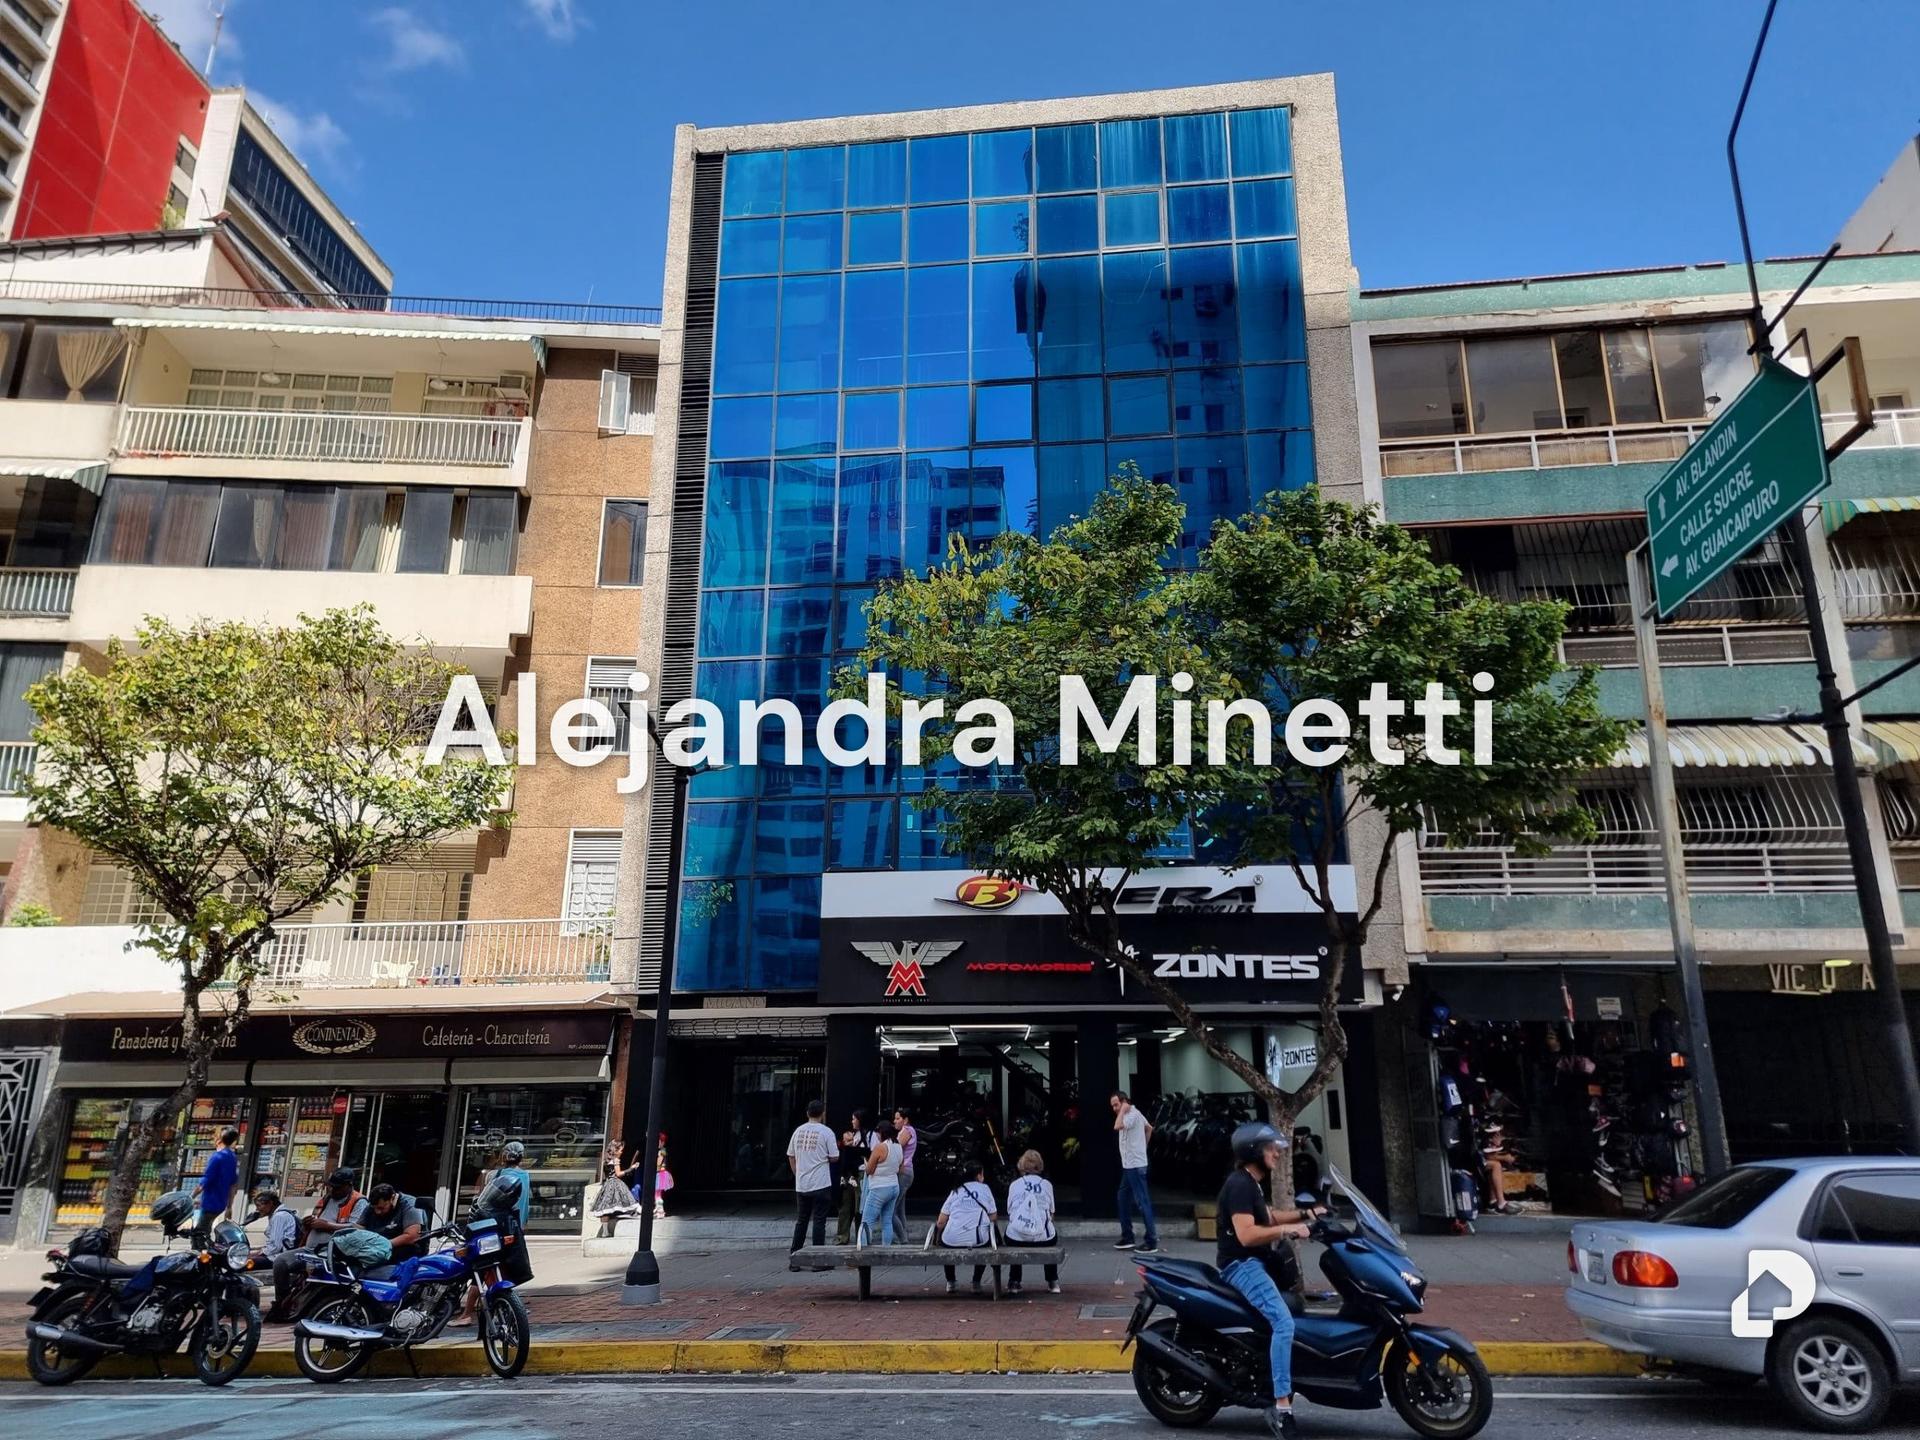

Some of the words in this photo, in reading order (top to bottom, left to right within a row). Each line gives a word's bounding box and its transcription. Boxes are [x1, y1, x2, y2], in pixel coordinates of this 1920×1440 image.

[1675, 471, 1690, 501] AV.
[1690, 421, 1738, 486] BLANDIN
[1680, 500, 1713, 546] CALLE
[1713, 463, 1754, 516] SUCRE
[1685, 550, 1700, 579] AV.
[1701, 480, 1780, 564] GUAICAIPURO
[1153, 954, 1320, 980] ZONTES
[171, 1036, 179, 1053] y
[307, 1027, 361, 1041] CONTINENTAL
[422, 1025, 474, 1046] Cafetería
[484, 1024, 550, 1045] Charcutería
[1285, 1048, 1317, 1066] ZONTES
